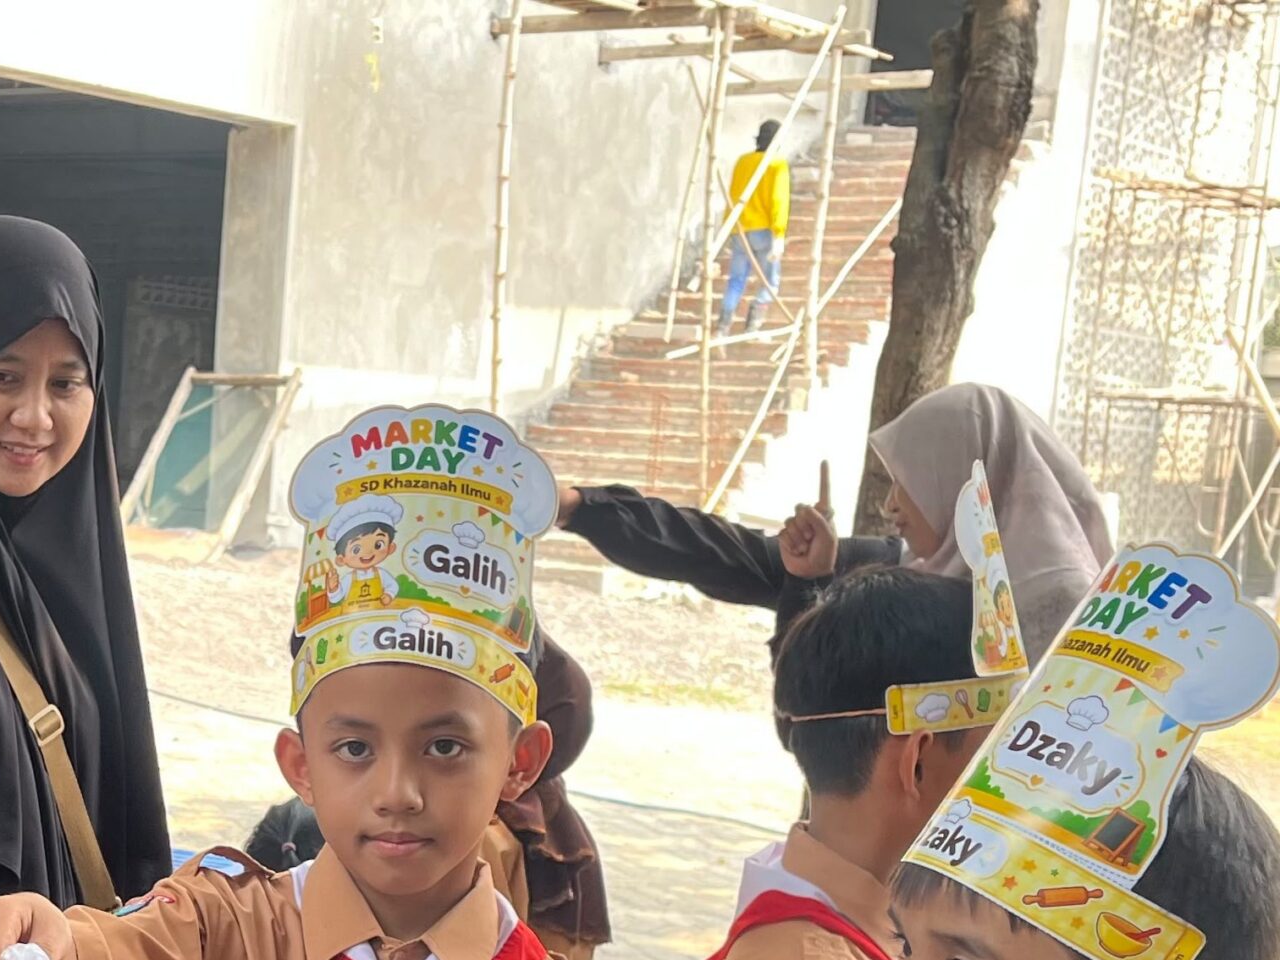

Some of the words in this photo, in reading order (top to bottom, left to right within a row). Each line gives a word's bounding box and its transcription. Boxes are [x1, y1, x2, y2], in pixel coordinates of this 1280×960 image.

[350, 419, 503, 460] MARKET
[391, 446, 465, 474] DAY
[360, 479, 379, 493] SD
[383, 477, 457, 493] Khazanah
[460, 483, 491, 501] Ilmu
[423, 544, 507, 594] Galih
[1074, 597, 1148, 635] DAY
[373, 626, 453, 660] Galih
[1112, 647, 1151, 673] Ilmu
[1008, 720, 1122, 795] Dzaky
